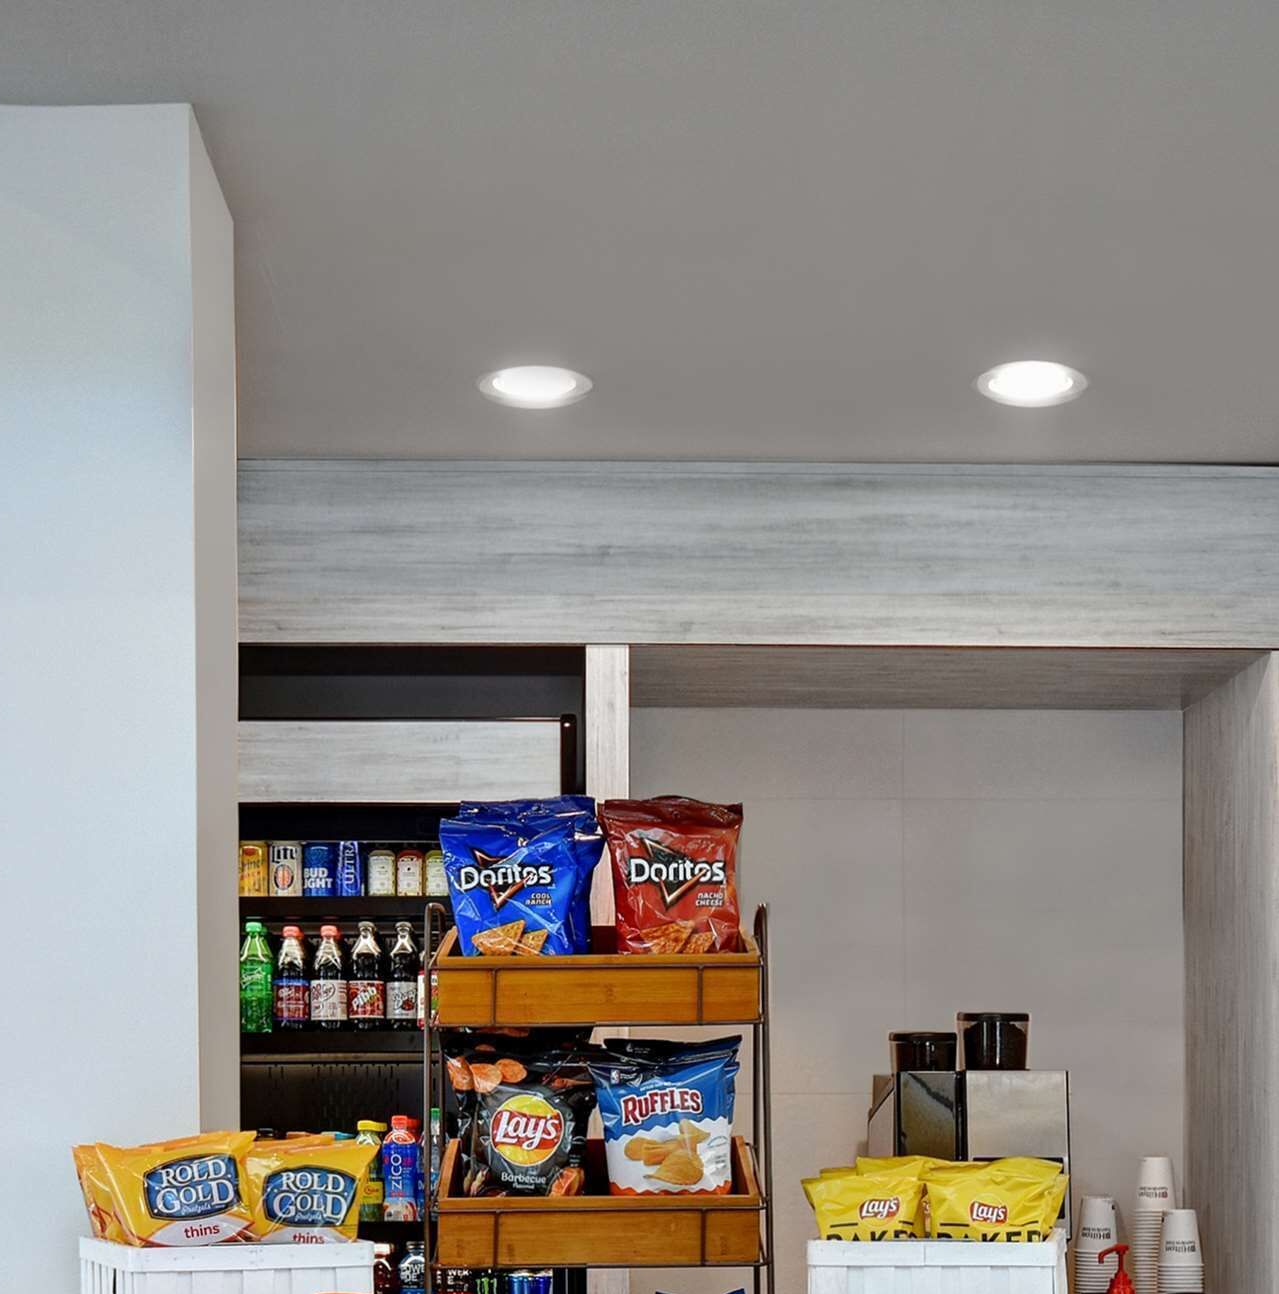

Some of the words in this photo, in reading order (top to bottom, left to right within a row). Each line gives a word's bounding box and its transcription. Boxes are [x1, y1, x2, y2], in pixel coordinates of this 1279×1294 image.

[344, 840, 355, 884] ULTRA
[629, 858, 726, 884] Doritos
[304, 867, 328, 878] BUD
[459, 864, 553, 891] Doritos
[524, 898, 553, 906] RANCH
[531, 892, 552, 900] COOL
[695, 899, 725, 907] CHEESE
[697, 892, 725, 900] NACHO
[622, 1088, 703, 1126] RUFFLES
[494, 1108, 561, 1150] Lay's
[161, 1158, 227, 1188] ROLD
[390, 1153, 402, 1190] ZICO
[500, 1171, 547, 1184] Barbecue
[281, 1172, 346, 1193] ROLD
[156, 1179, 235, 1214] GOLD
[273, 1192, 348, 1220] GOLD
[861, 1198, 898, 1218] Lay's
[972, 1202, 1007, 1222] Lay's
[184, 1223, 220, 1239] thins
[292, 1233, 325, 1244] thins
